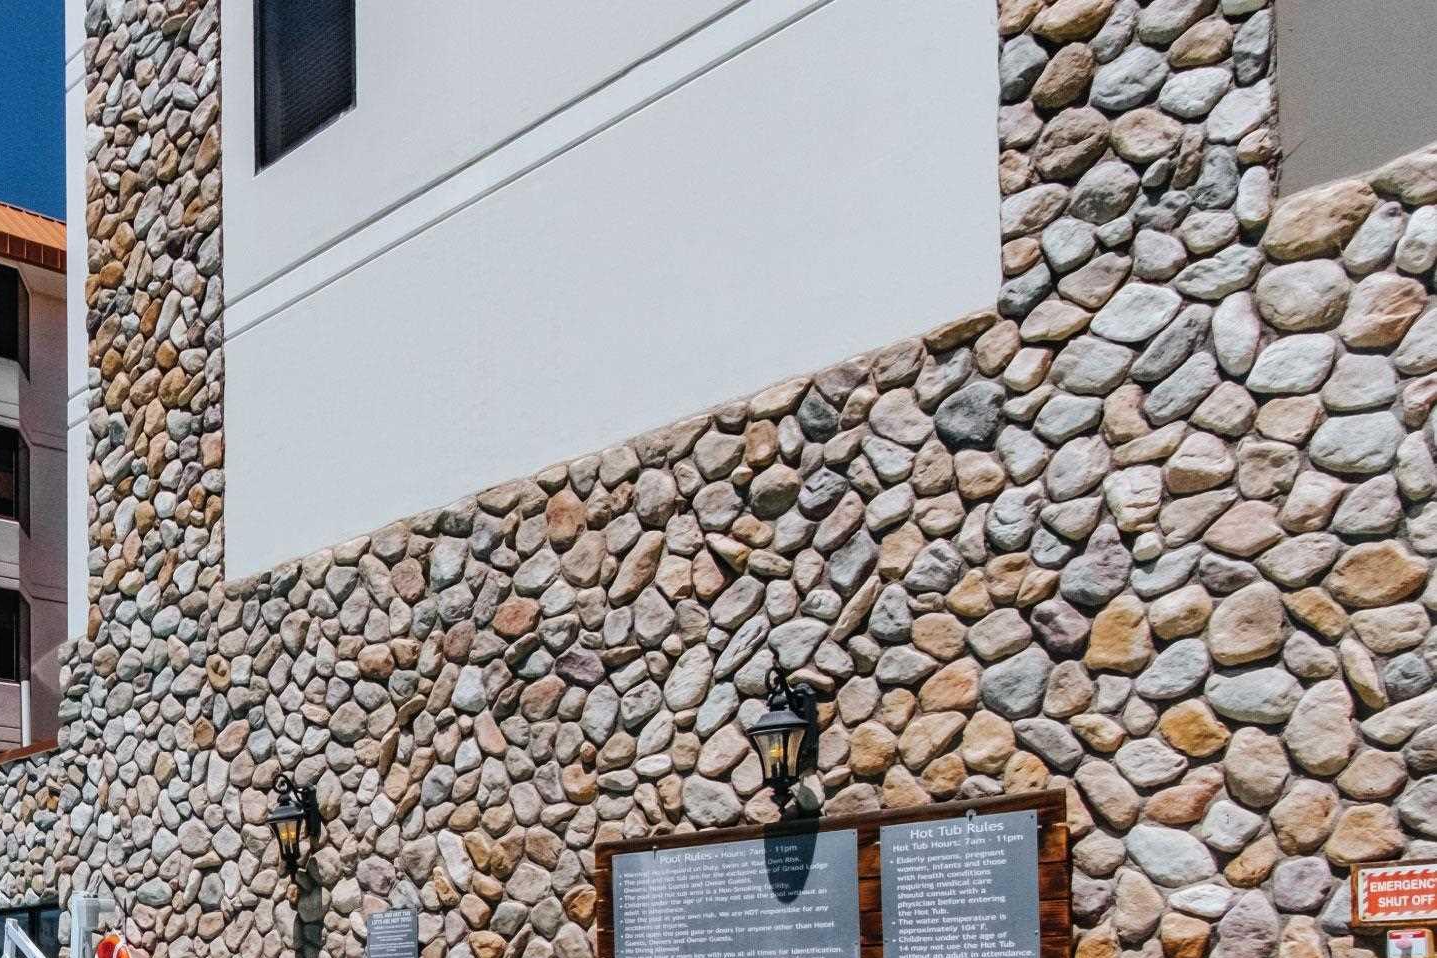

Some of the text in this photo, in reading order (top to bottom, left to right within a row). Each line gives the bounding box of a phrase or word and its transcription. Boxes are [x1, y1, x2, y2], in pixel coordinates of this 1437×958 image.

[910, 820, 1004, 839] Hot Tub Rules
[893, 832, 1024, 852] Hot Tub Hours: 7am 11pm
[684, 851, 712, 861] Rules
[896, 856, 925, 864] Elderly
[964, 848, 1004, 859] pregnant
[897, 865, 929, 873] women,
[947, 868, 991, 877] conditions
[896, 881, 934, 891] requiring
[1370, 878, 1436, 892] EMERGENC
[897, 899, 935, 908] physician
[968, 894, 1006, 904] entering
[1379, 894, 1435, 907] SHUT OFF
[942, 914, 997, 923] temperature
[899, 925, 958, 934] approximately
